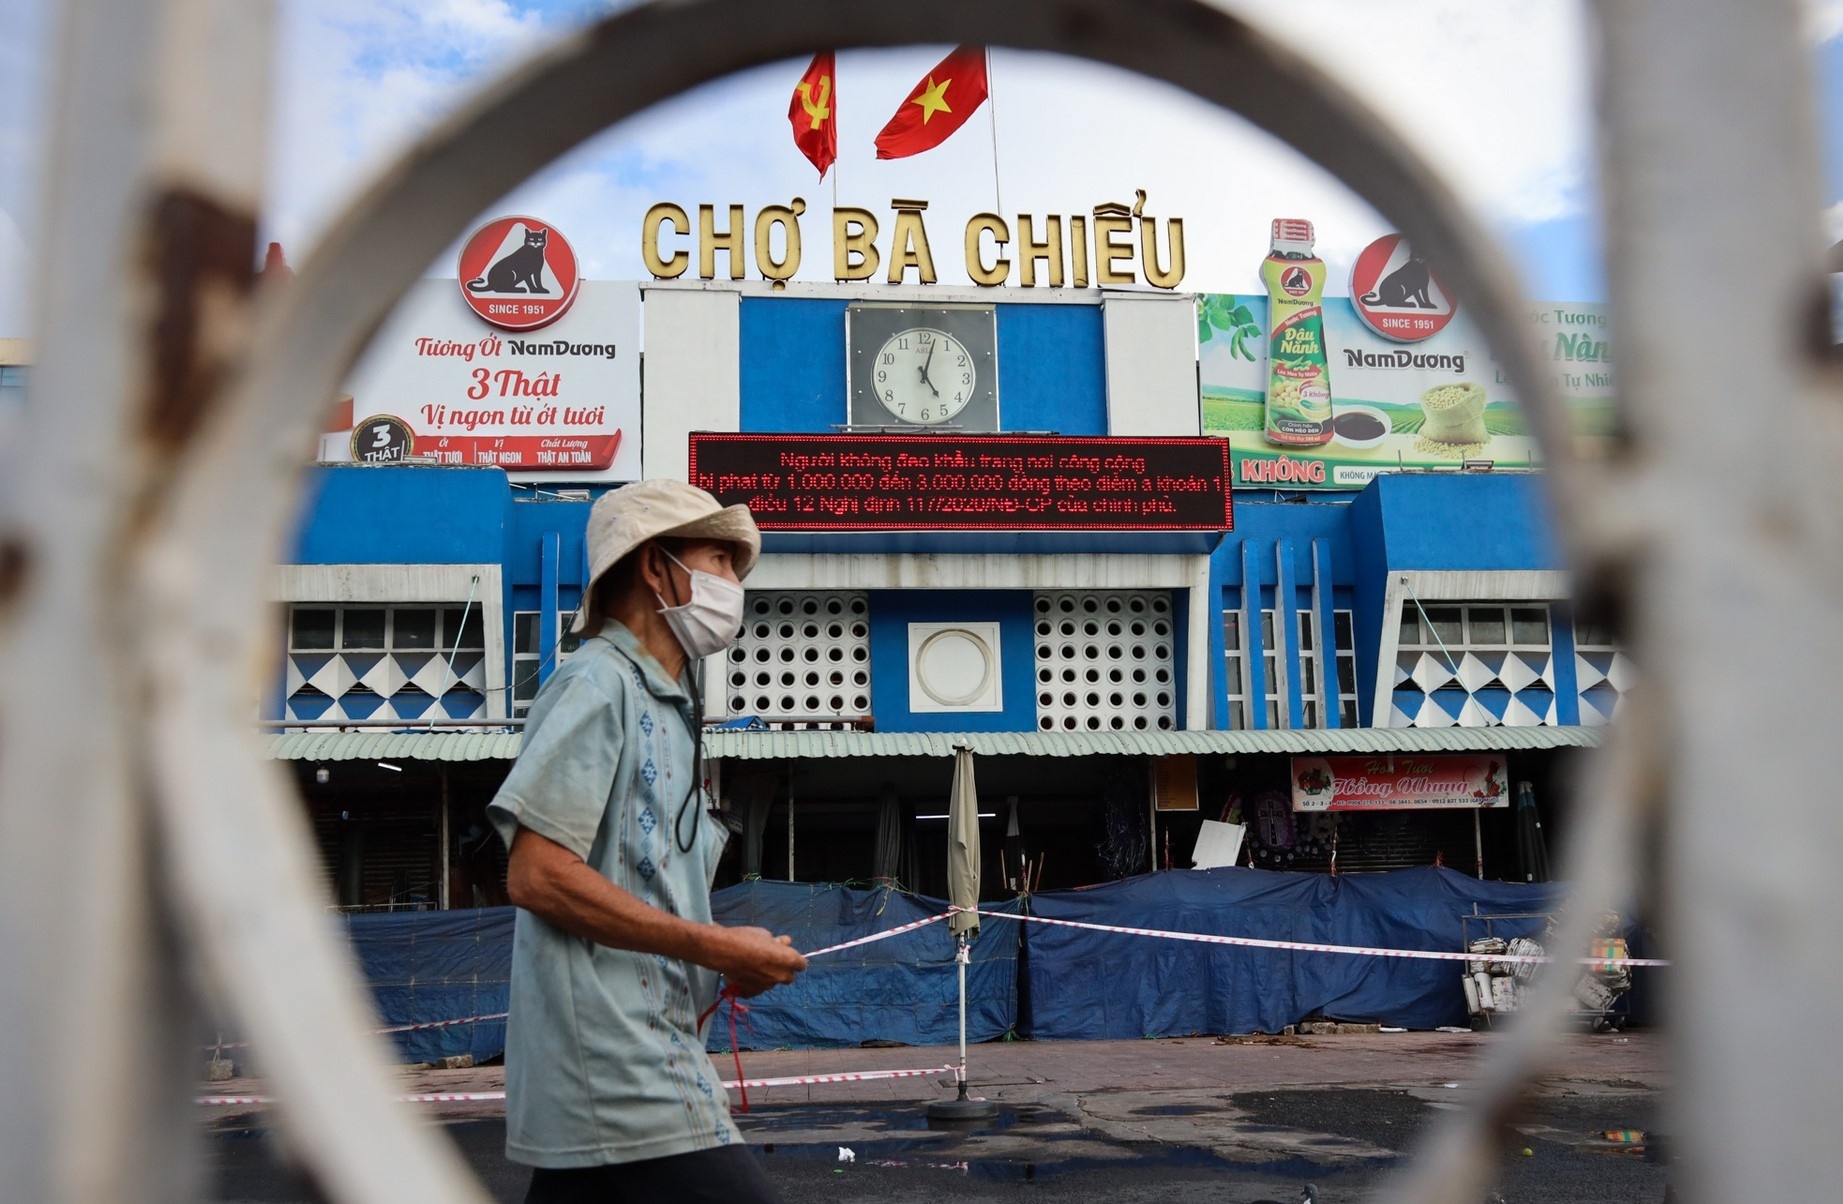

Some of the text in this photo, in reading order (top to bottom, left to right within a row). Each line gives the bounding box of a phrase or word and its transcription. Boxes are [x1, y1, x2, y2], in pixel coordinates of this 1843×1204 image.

[642, 197, 806, 291] CHỢ
[965, 189, 1185, 290] CHIỂU
[489, 304, 544, 315] SINCE 1951
[1382, 318, 1434, 329] SINCE 1951
[898, 338, 910, 351] 11
[918, 332, 931, 345] 12
[414, 332, 616, 362] Tương Ớt NamDương
[944, 340, 951, 352] 1
[882, 353, 895, 365] 10
[957, 355, 966, 367] 2
[1342, 348, 1465, 373] NamDương
[878, 370, 887, 383] 9
[961, 373, 971, 385] 3
[467, 367, 562, 401] 3 Thật
[884, 389, 894, 402] 8
[954, 391, 963, 403] 4
[897, 402, 906, 415] 7
[921, 408, 930, 421] 6
[940, 404, 949, 416] 5
[420, 403, 605, 431] Vị ngon từ ớt tươi
[371, 424, 392, 448] 3
[499, 451, 522, 464] NGON
[536, 449, 592, 466] THẬT AN TOÀN
[780, 452, 835, 472] Người
[840, 452, 892, 472] không
[979, 454, 1023, 473] trang
[1241, 454, 1326, 483] KHÔNG
[787, 473, 874, 490] 1.000.000
[917, 474, 1003, 491] 3.000.000
[1054, 475, 1092, 491] theo
[1141, 478, 1152, 491] a
[1213, 475, 1220, 492] 1
[794, 496, 814, 512] 12
[1332, 776, 1393, 798] Hồng
